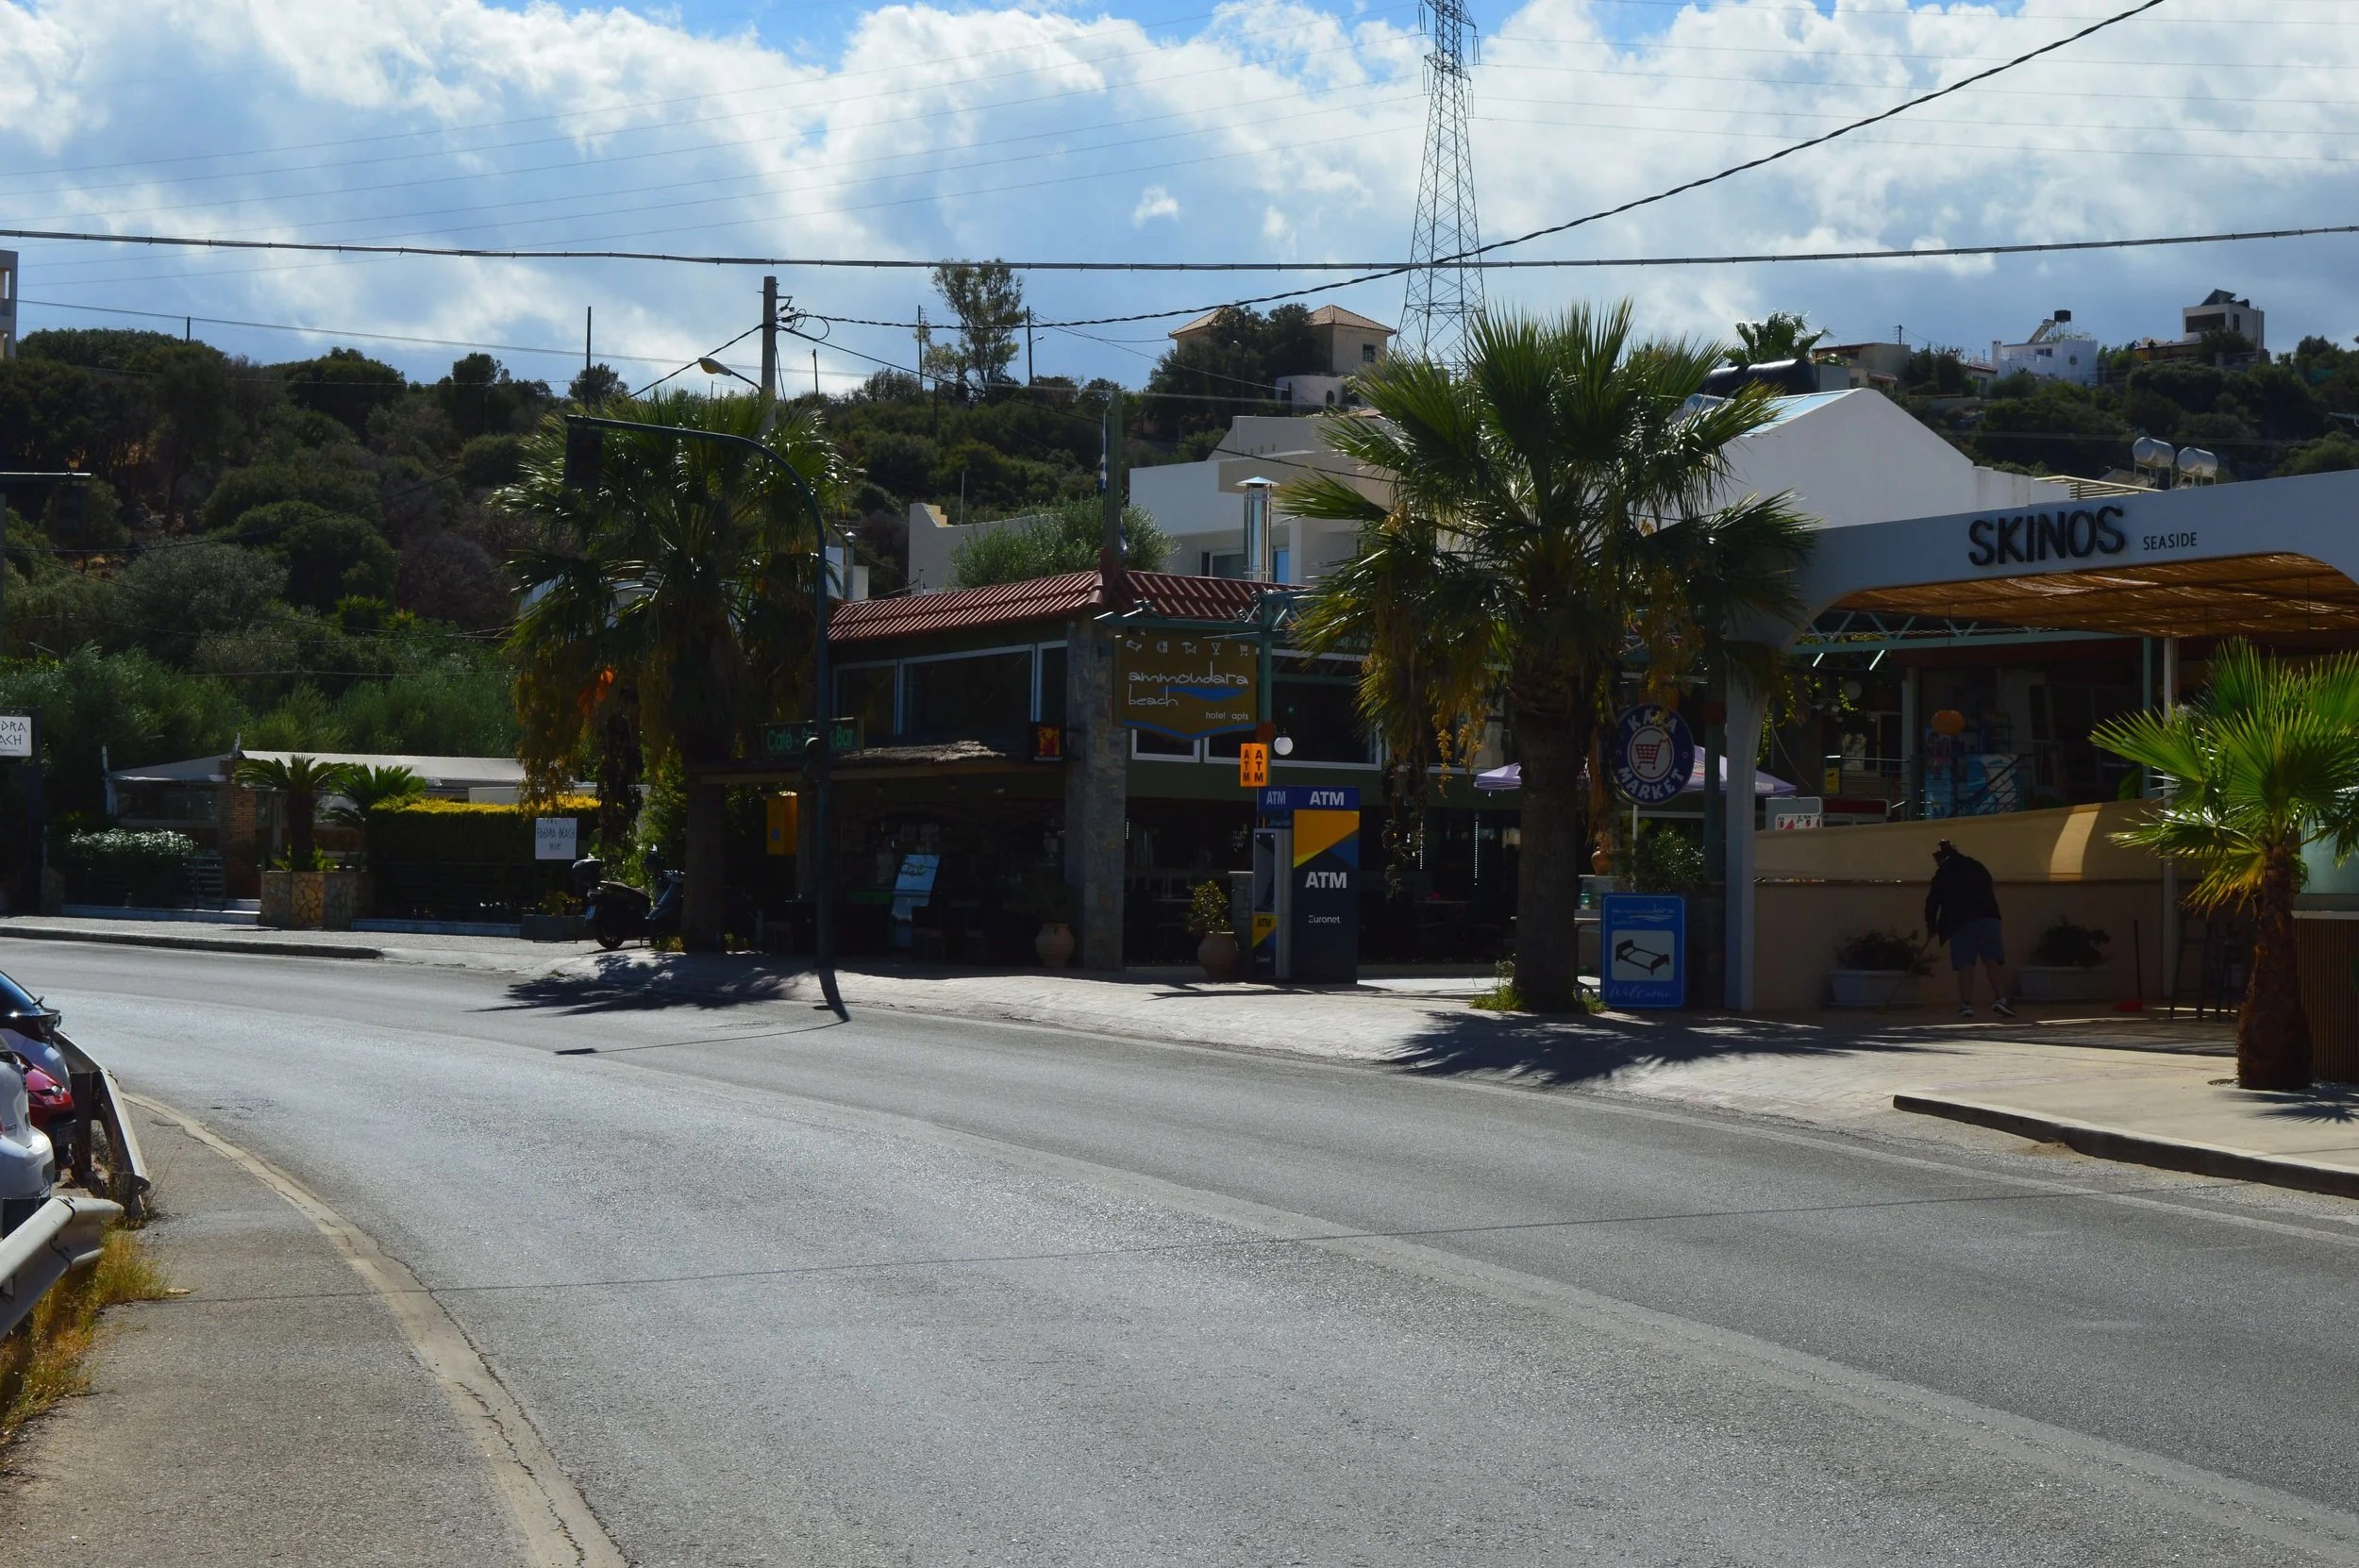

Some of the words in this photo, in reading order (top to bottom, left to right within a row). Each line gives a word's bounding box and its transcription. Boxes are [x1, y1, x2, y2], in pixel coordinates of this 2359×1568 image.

[1968, 505, 2126, 566] SKINOS
[2143, 531, 2198, 551] SEASIDE
[1128, 660, 1249, 686] ammoudara
[1128, 683, 1179, 707] beach
[1205, 710, 1226, 720] hotel
[1230, 711, 1249, 722] apts
[836, 724, 855, 748] Bar
[1254, 749, 1264, 783] ATM
[1617, 765, 1685, 801] MARKET
[1265, 791, 1287, 806] ATM
[1309, 791, 1345, 807] ATM
[1304, 871, 1347, 889] ATM
